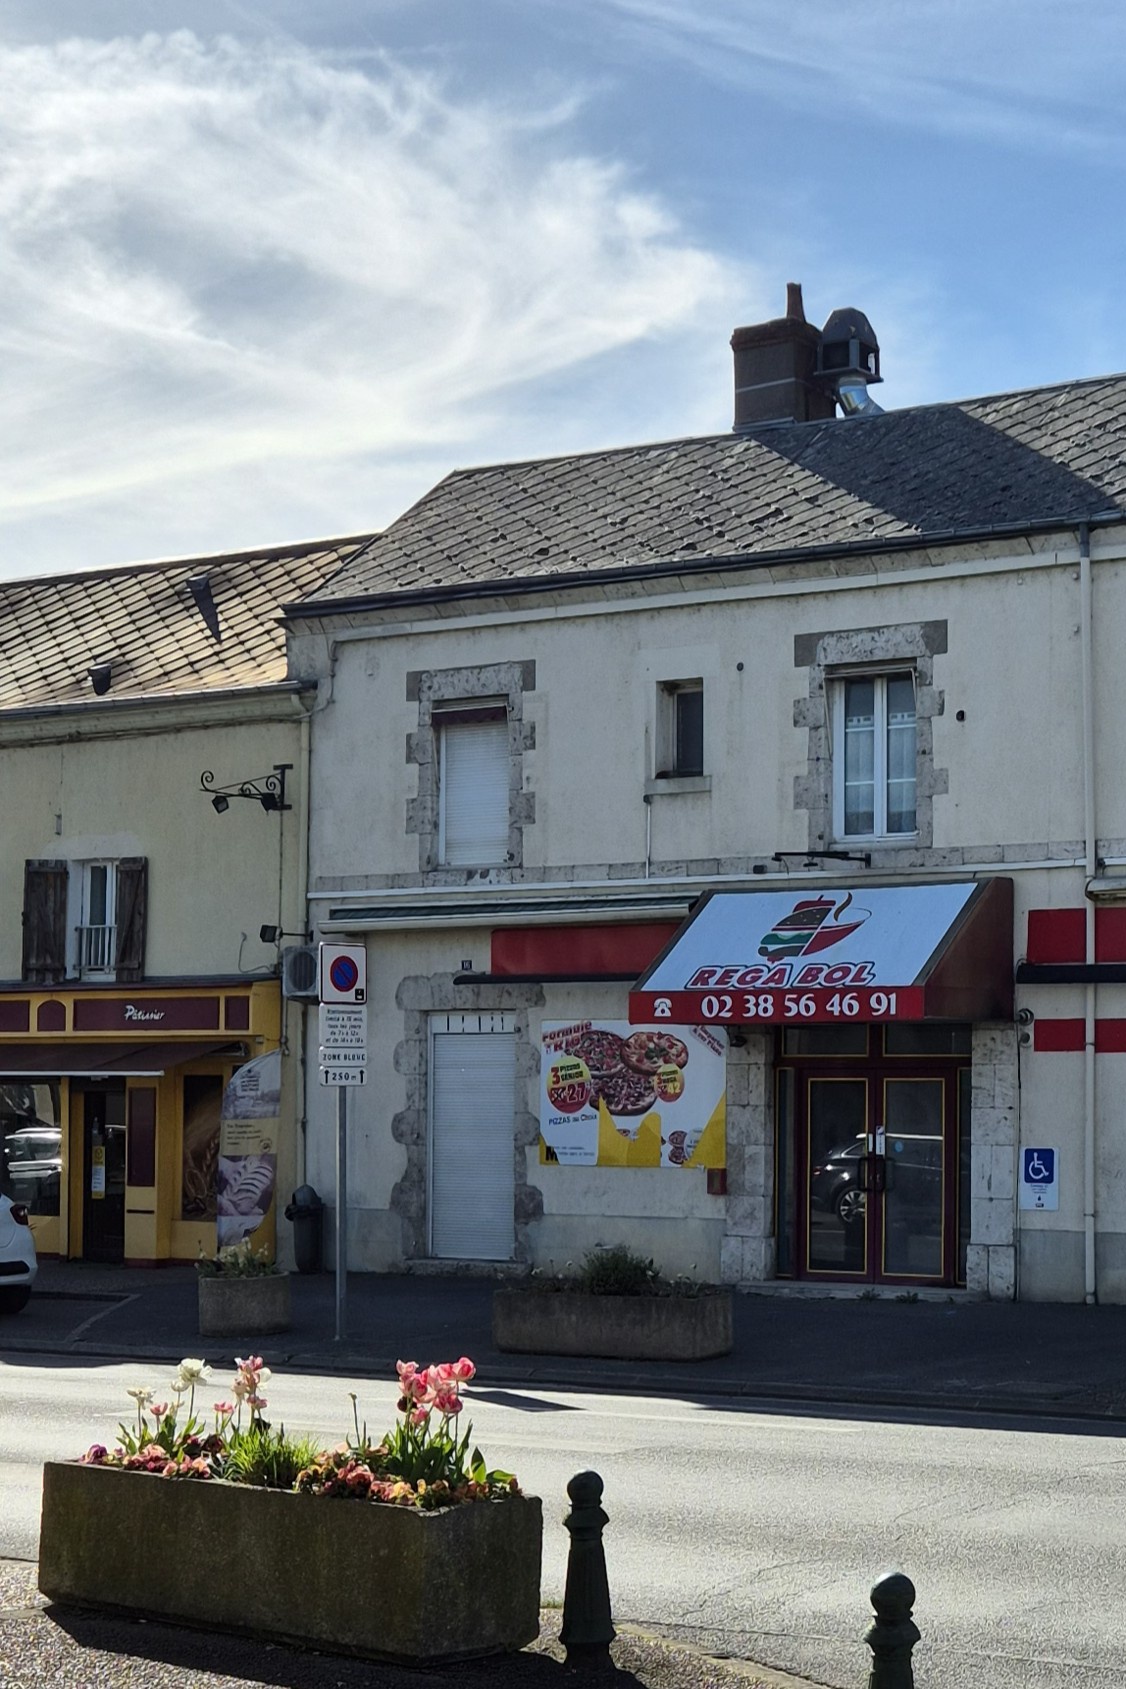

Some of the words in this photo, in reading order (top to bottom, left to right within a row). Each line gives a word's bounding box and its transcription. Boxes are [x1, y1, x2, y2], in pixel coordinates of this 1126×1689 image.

[687, 966, 791, 988] REGA
[796, 963, 876, 987] BOL
[701, 994, 733, 1018] 02
[742, 994, 775, 1018] 38
[784, 993, 817, 1017] 56
[825, 992, 860, 1017] 46
[869, 991, 897, 1016] 91
[323, 1053, 341, 1061] ZONE
[343, 1053, 365, 1061] BLEUE
[332, 1072, 350, 1081] 250
[551, 1066, 560, 1085] 3
[548, 1116, 571, 1126] PIZZAS
